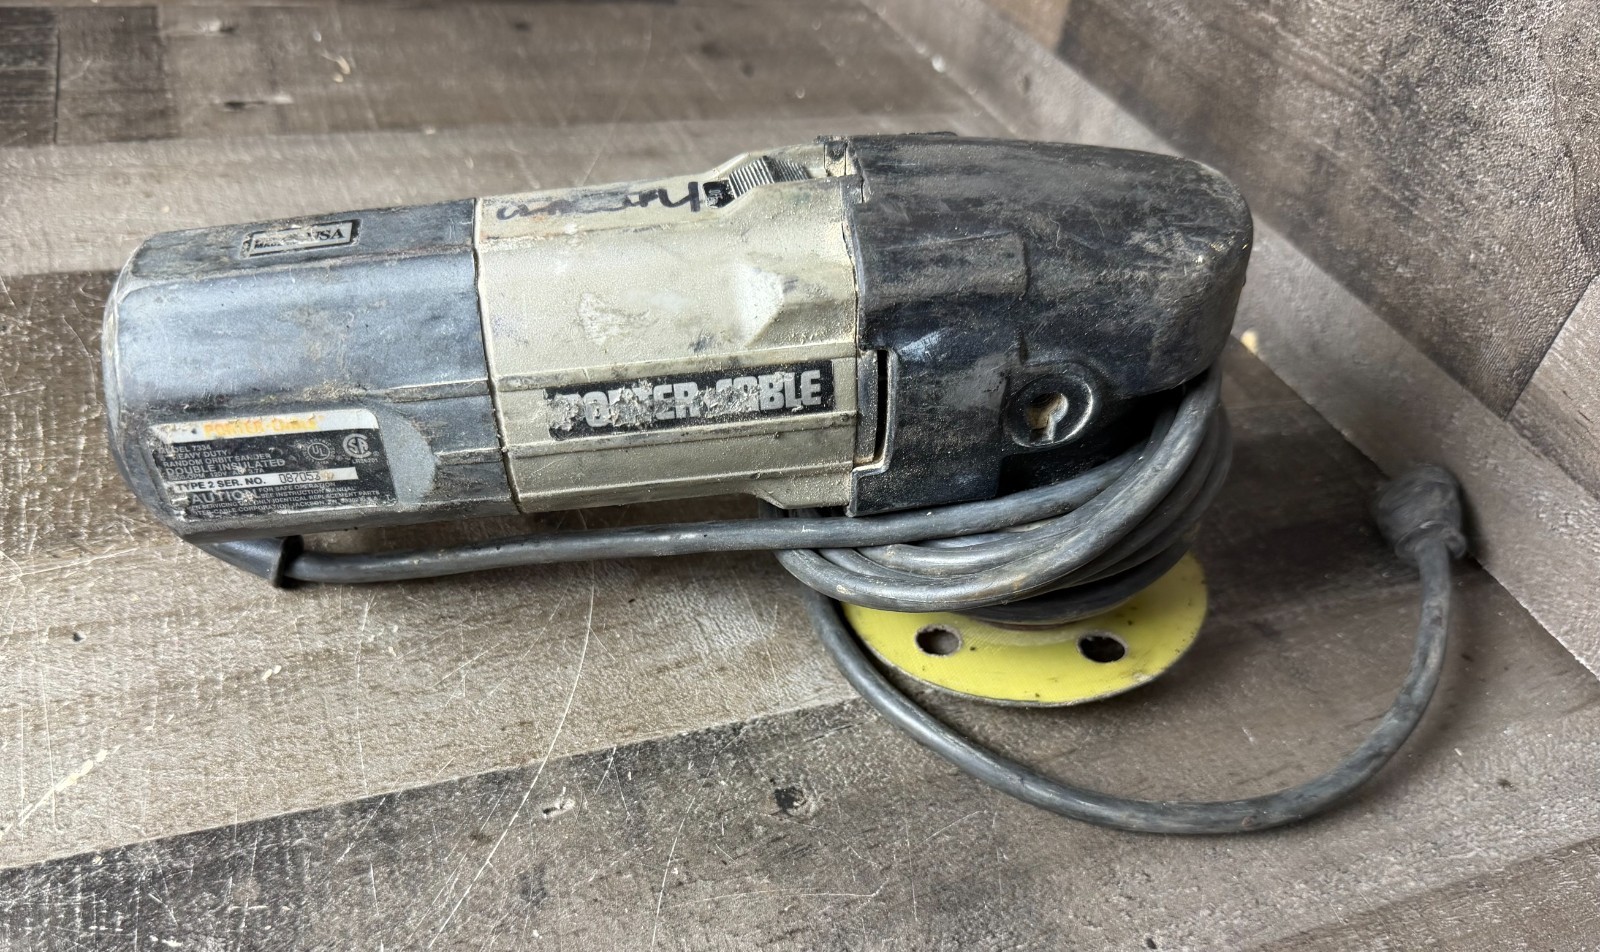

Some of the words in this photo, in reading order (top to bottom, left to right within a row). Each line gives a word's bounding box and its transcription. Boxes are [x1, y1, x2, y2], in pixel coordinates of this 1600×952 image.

[547, 369, 821, 431] OTERABLE
[163, 459, 204, 467] RANDOM
[205, 456, 233, 465] ORBIT
[235, 453, 272, 462] SANDER
[172, 452, 201, 461] EAVY
[203, 450, 228, 458] DUTY
[166, 465, 216, 476] DOUBLE
[218, 458, 286, 472] INSULATED
[176, 481, 207, 491] TYPE
[208, 480, 216, 489] 2
[217, 479, 243, 488] SER.
[245, 477, 267, 486] NO.
[190, 488, 260, 504] AUTION
